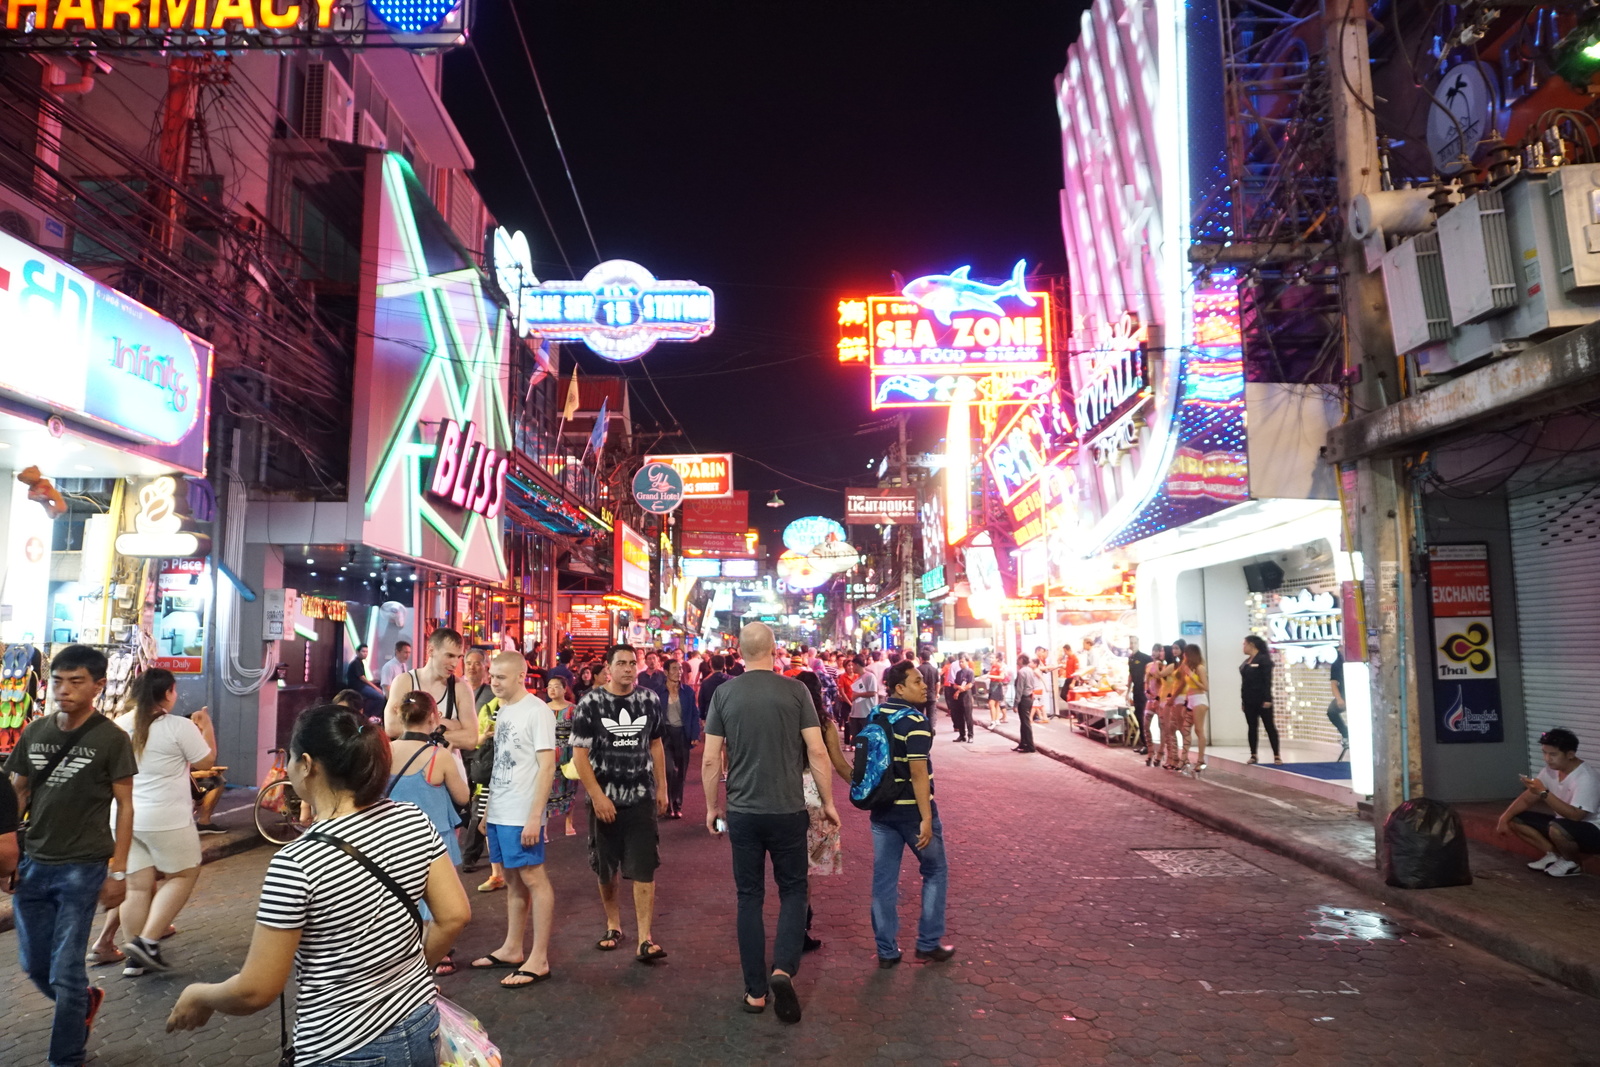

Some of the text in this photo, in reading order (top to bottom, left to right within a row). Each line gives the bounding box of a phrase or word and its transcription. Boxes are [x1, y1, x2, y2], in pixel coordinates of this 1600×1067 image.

[643, 294, 711, 320] STATION
[876, 317, 1043, 348] SEA ZONE
[920, 349, 967, 364] FOOD
[1075, 350, 1138, 438] SKYFALL
[430, 418, 508, 519] BLISS
[670, 461, 725, 478] NDARIN
[636, 492, 680, 500] Grand Hotel
[847, 500, 915, 512] LIGHTHOUSE
[601, 506, 614, 526] BLACK
[171, 558, 203, 571] Place
[1431, 585, 1491, 603] EXCHANGE
[1270, 614, 1343, 642] SKYFALL
[172, 659, 191, 670] Daily
[1439, 664, 1468, 675] Thai
[1464, 706, 1499, 722] Bangkok
[1457, 716, 1491, 734] Airways
[30, 743, 62, 753] ARMAN
[612, 738, 639, 746] adidas
[68, 745, 97, 758] EANS
